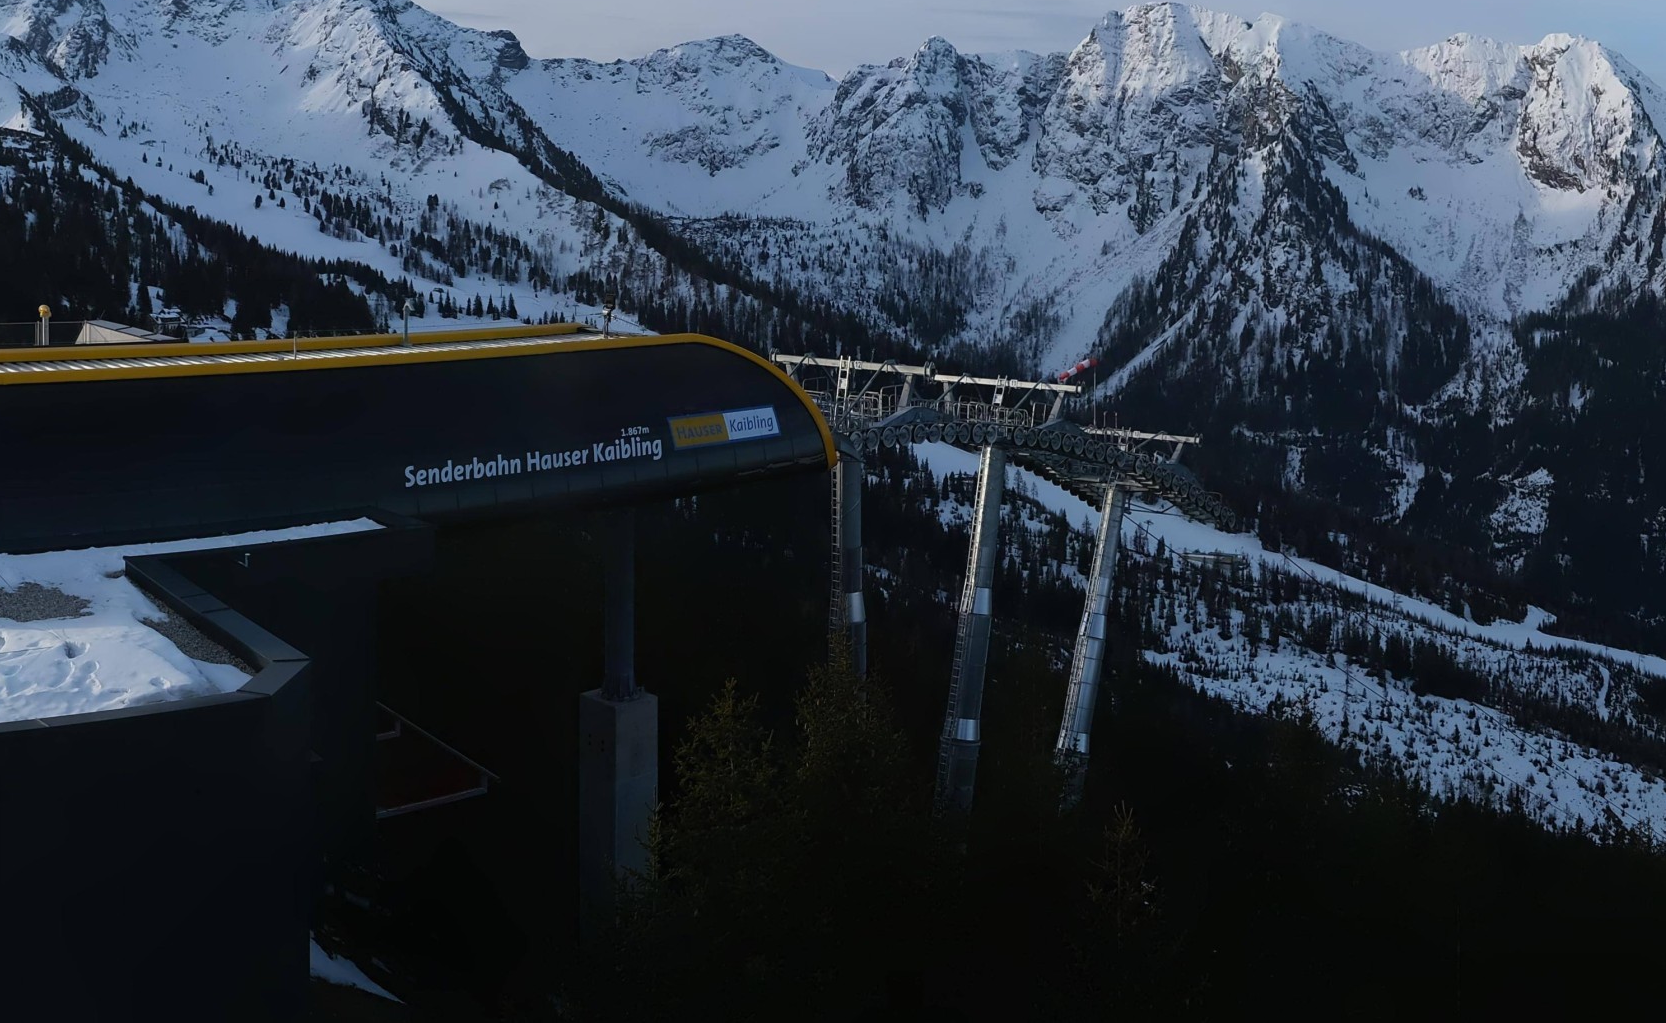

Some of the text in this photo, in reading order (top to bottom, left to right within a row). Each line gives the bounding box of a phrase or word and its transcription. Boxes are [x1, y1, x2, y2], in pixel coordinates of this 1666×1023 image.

[620, 425, 650, 437] 1.867m
[675, 415, 774, 439] HAUSER Kaibling
[404, 437, 663, 488] Senderbahn Hauser Kaibling
